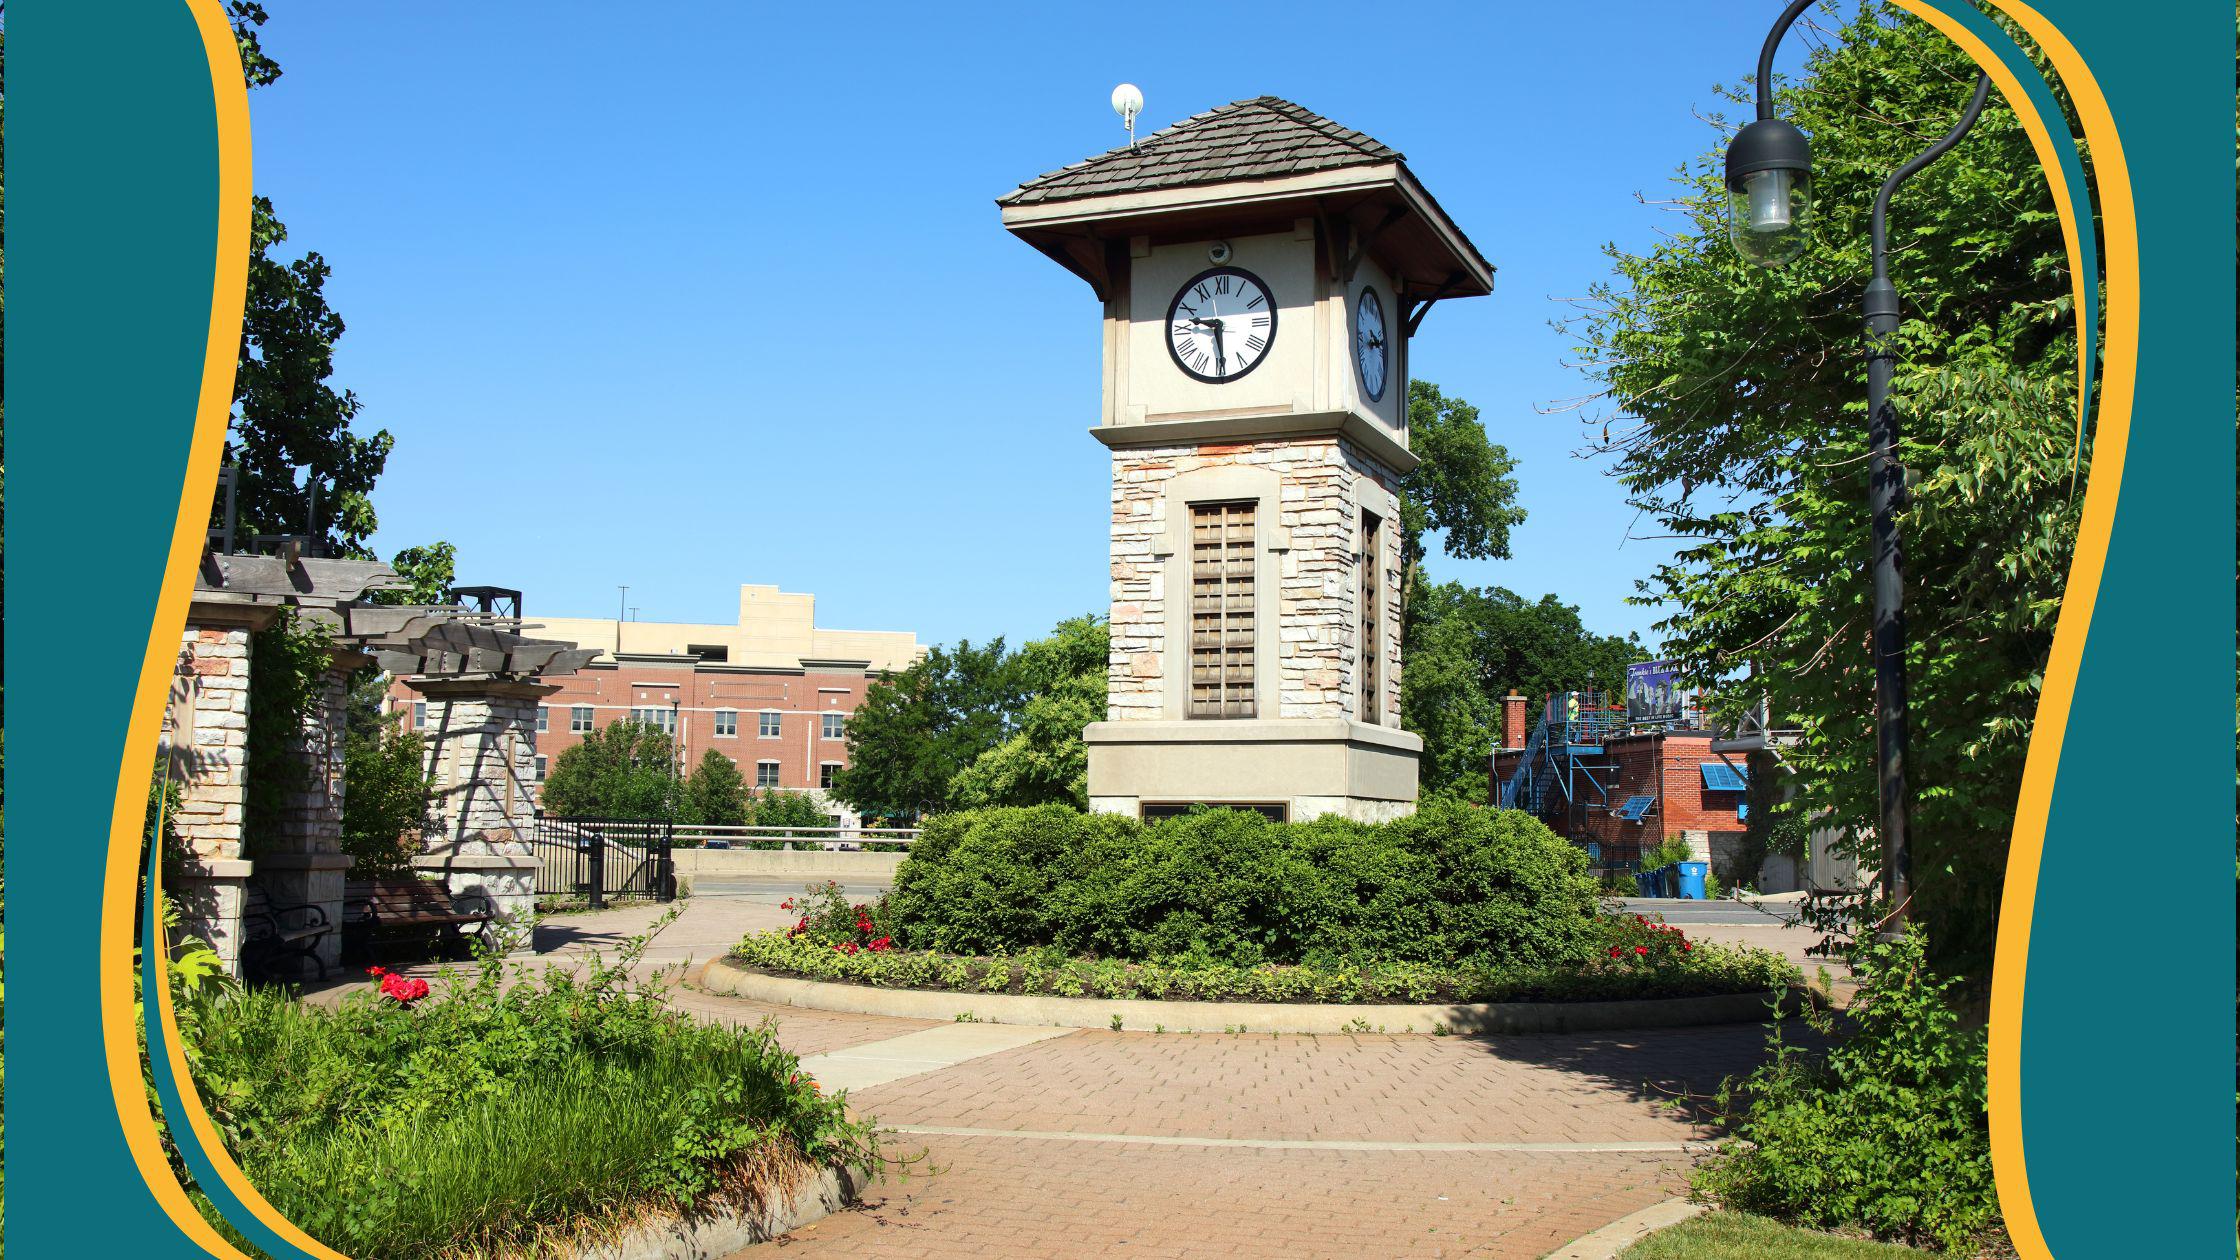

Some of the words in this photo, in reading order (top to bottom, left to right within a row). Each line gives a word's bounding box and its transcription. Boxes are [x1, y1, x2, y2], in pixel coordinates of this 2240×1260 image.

[1193, 282, 1211, 304] XI
[1215, 275, 1230, 296] XII
[1235, 280, 1247, 298] I
[1178, 301, 1198, 316] X
[1246, 294, 1265, 310] II
[1173, 323, 1192, 336] IX
[1251, 316, 1270, 328] III
[1176, 337, 1198, 361] VIII
[1244, 333, 1266, 353] IIII
[1191, 351, 1210, 374] VII
[1235, 351, 1248, 369] V
